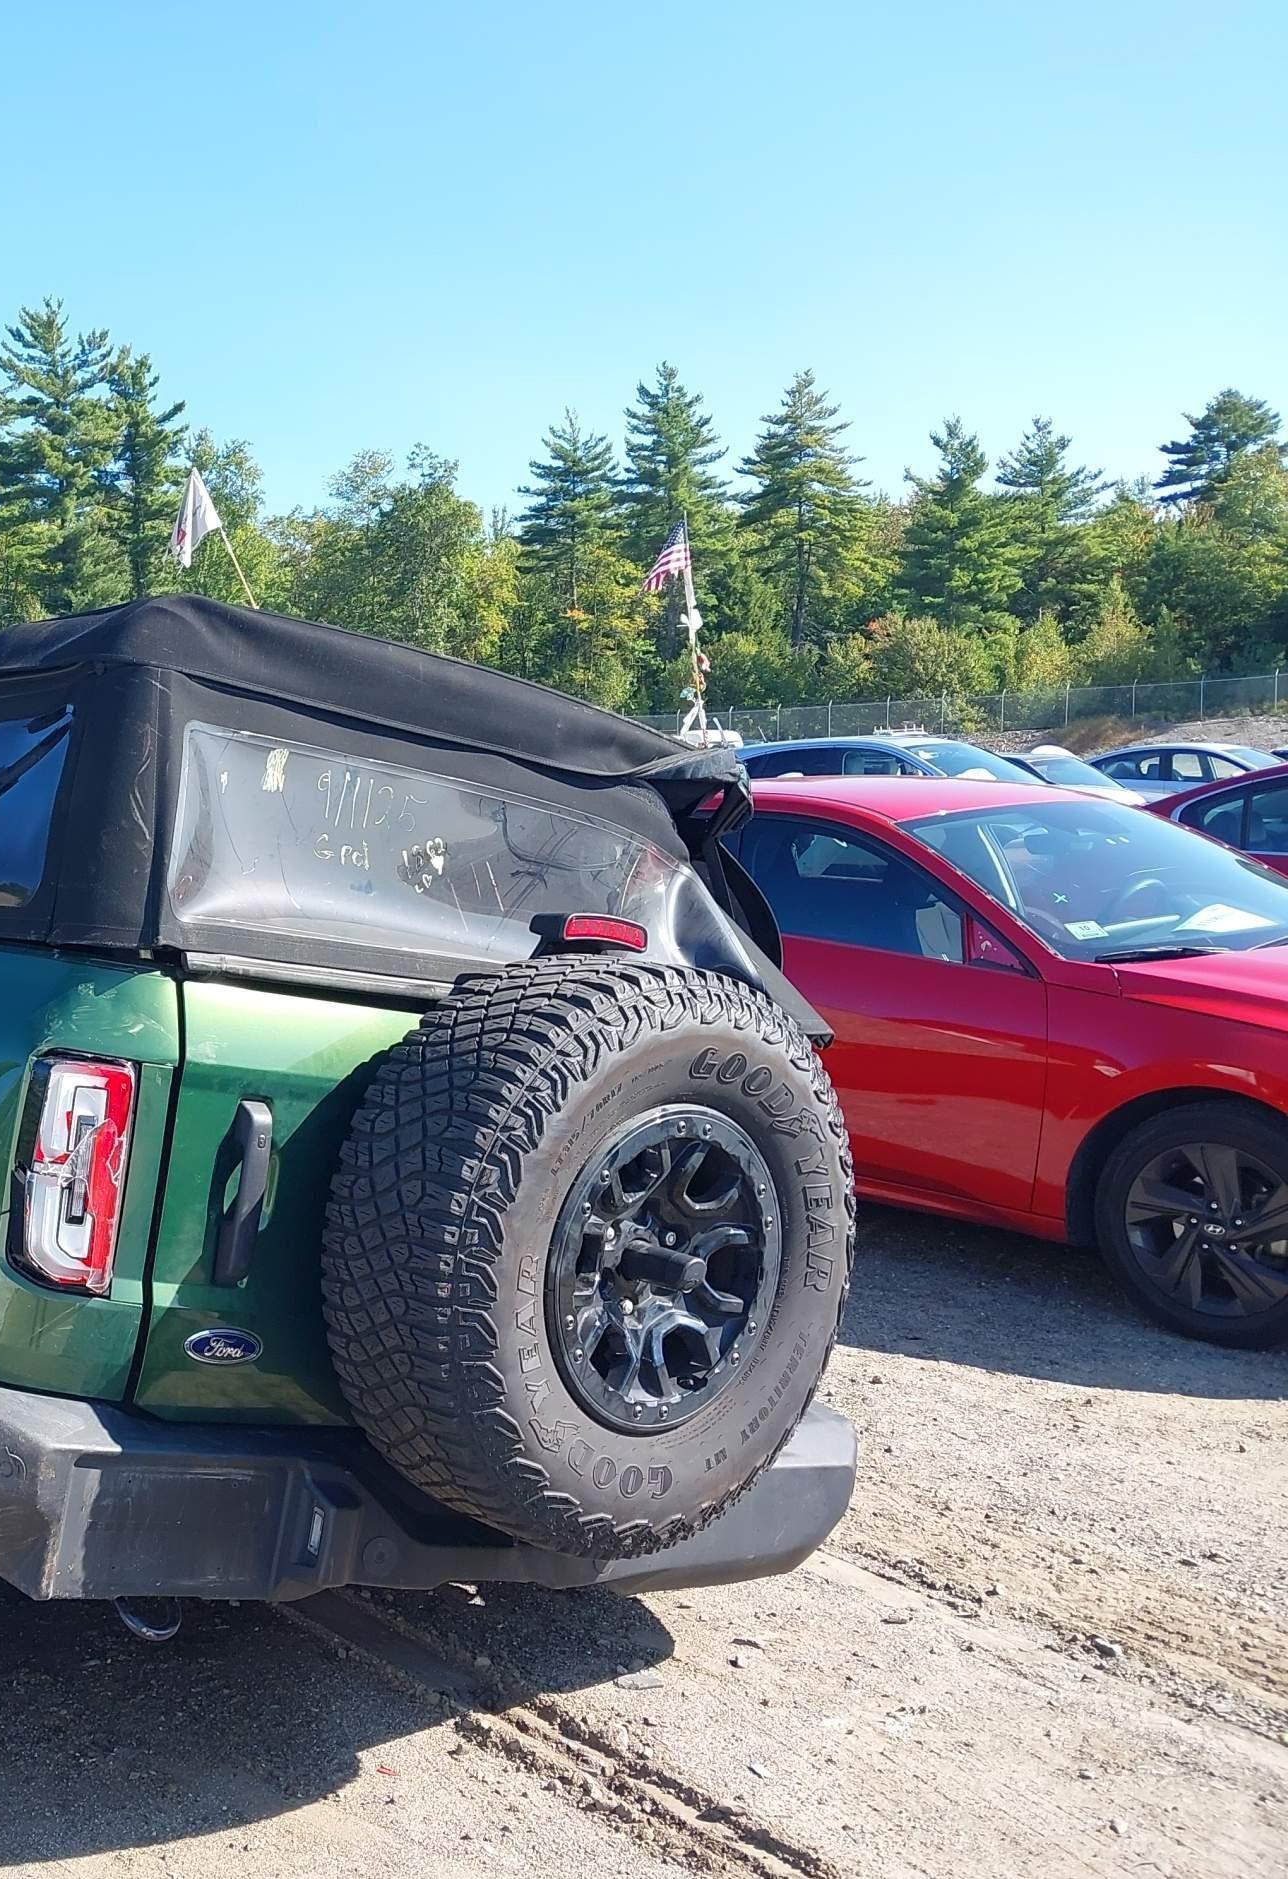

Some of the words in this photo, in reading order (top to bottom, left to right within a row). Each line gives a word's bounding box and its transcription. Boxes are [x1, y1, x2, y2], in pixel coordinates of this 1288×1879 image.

[203, 1336, 245, 1358] Ford
[740, 1331, 810, 1446] TERRITORY
[704, 1447, 728, 1473] MT
